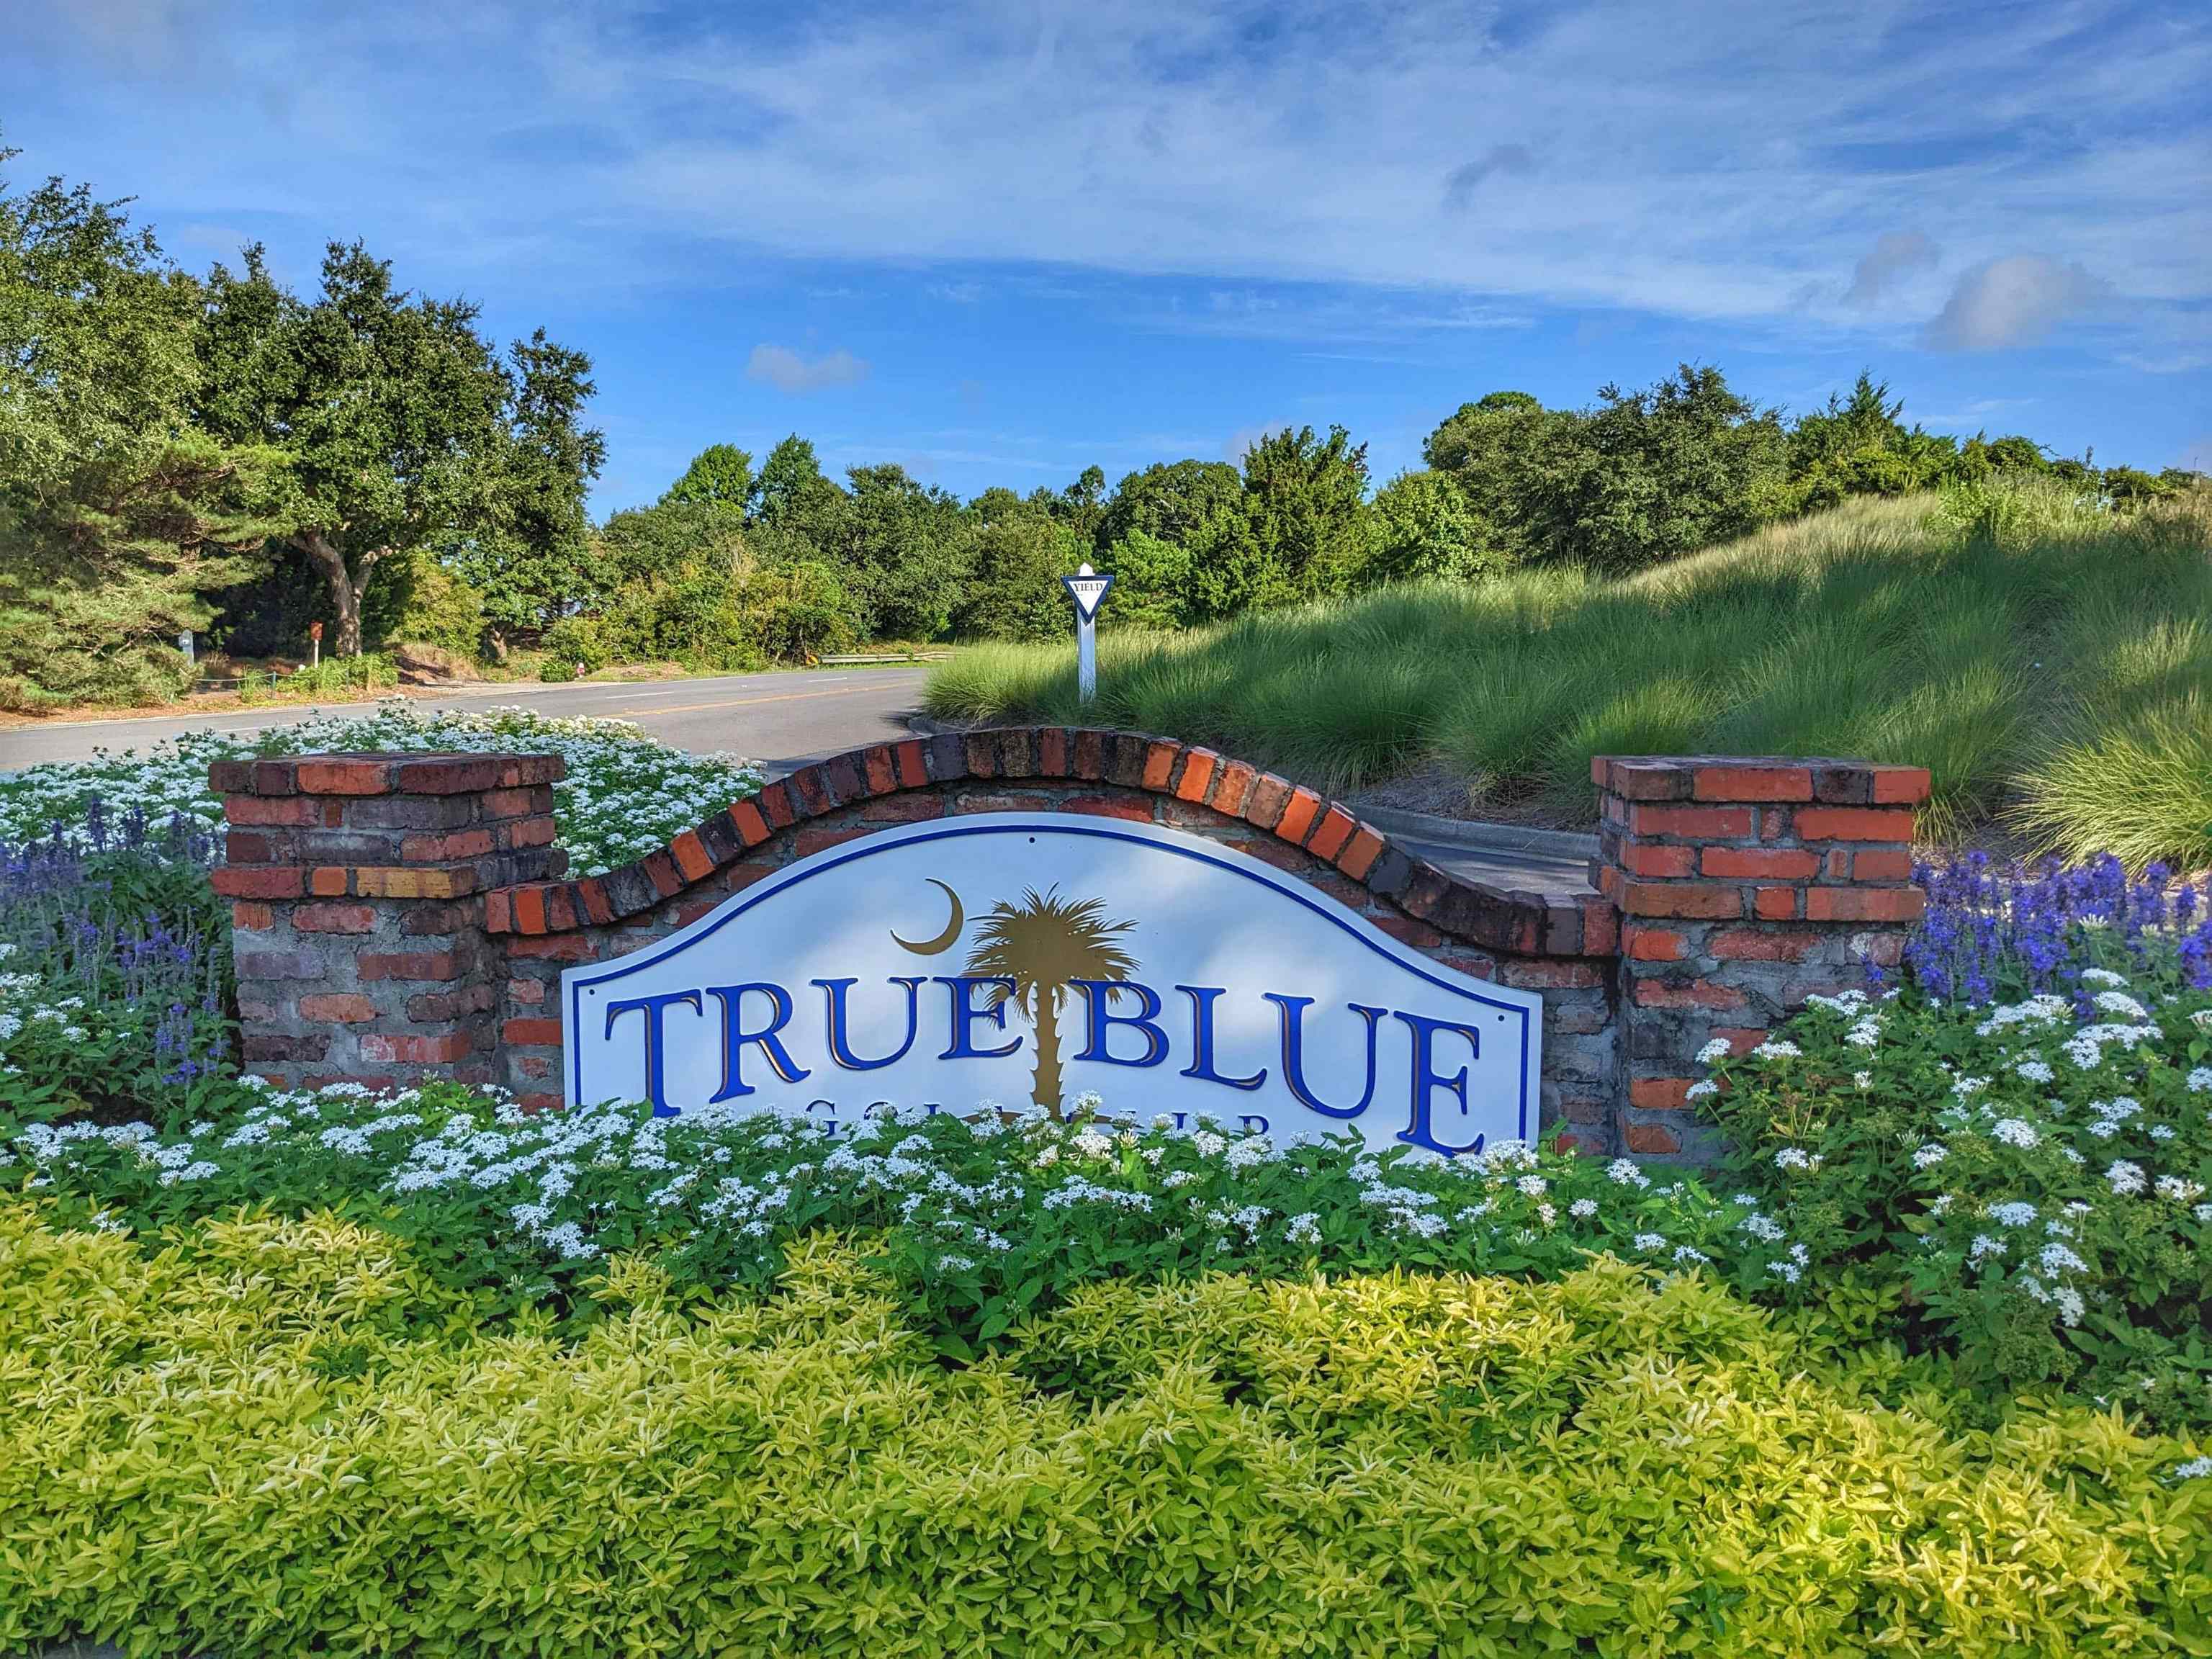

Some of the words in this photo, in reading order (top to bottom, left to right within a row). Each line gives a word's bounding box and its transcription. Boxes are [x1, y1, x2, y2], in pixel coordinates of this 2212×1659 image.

[1074, 583, 1103, 591] YIELD
[605, 976, 1023, 1118] TRUE
[1069, 979, 1485, 1159] BLUE
